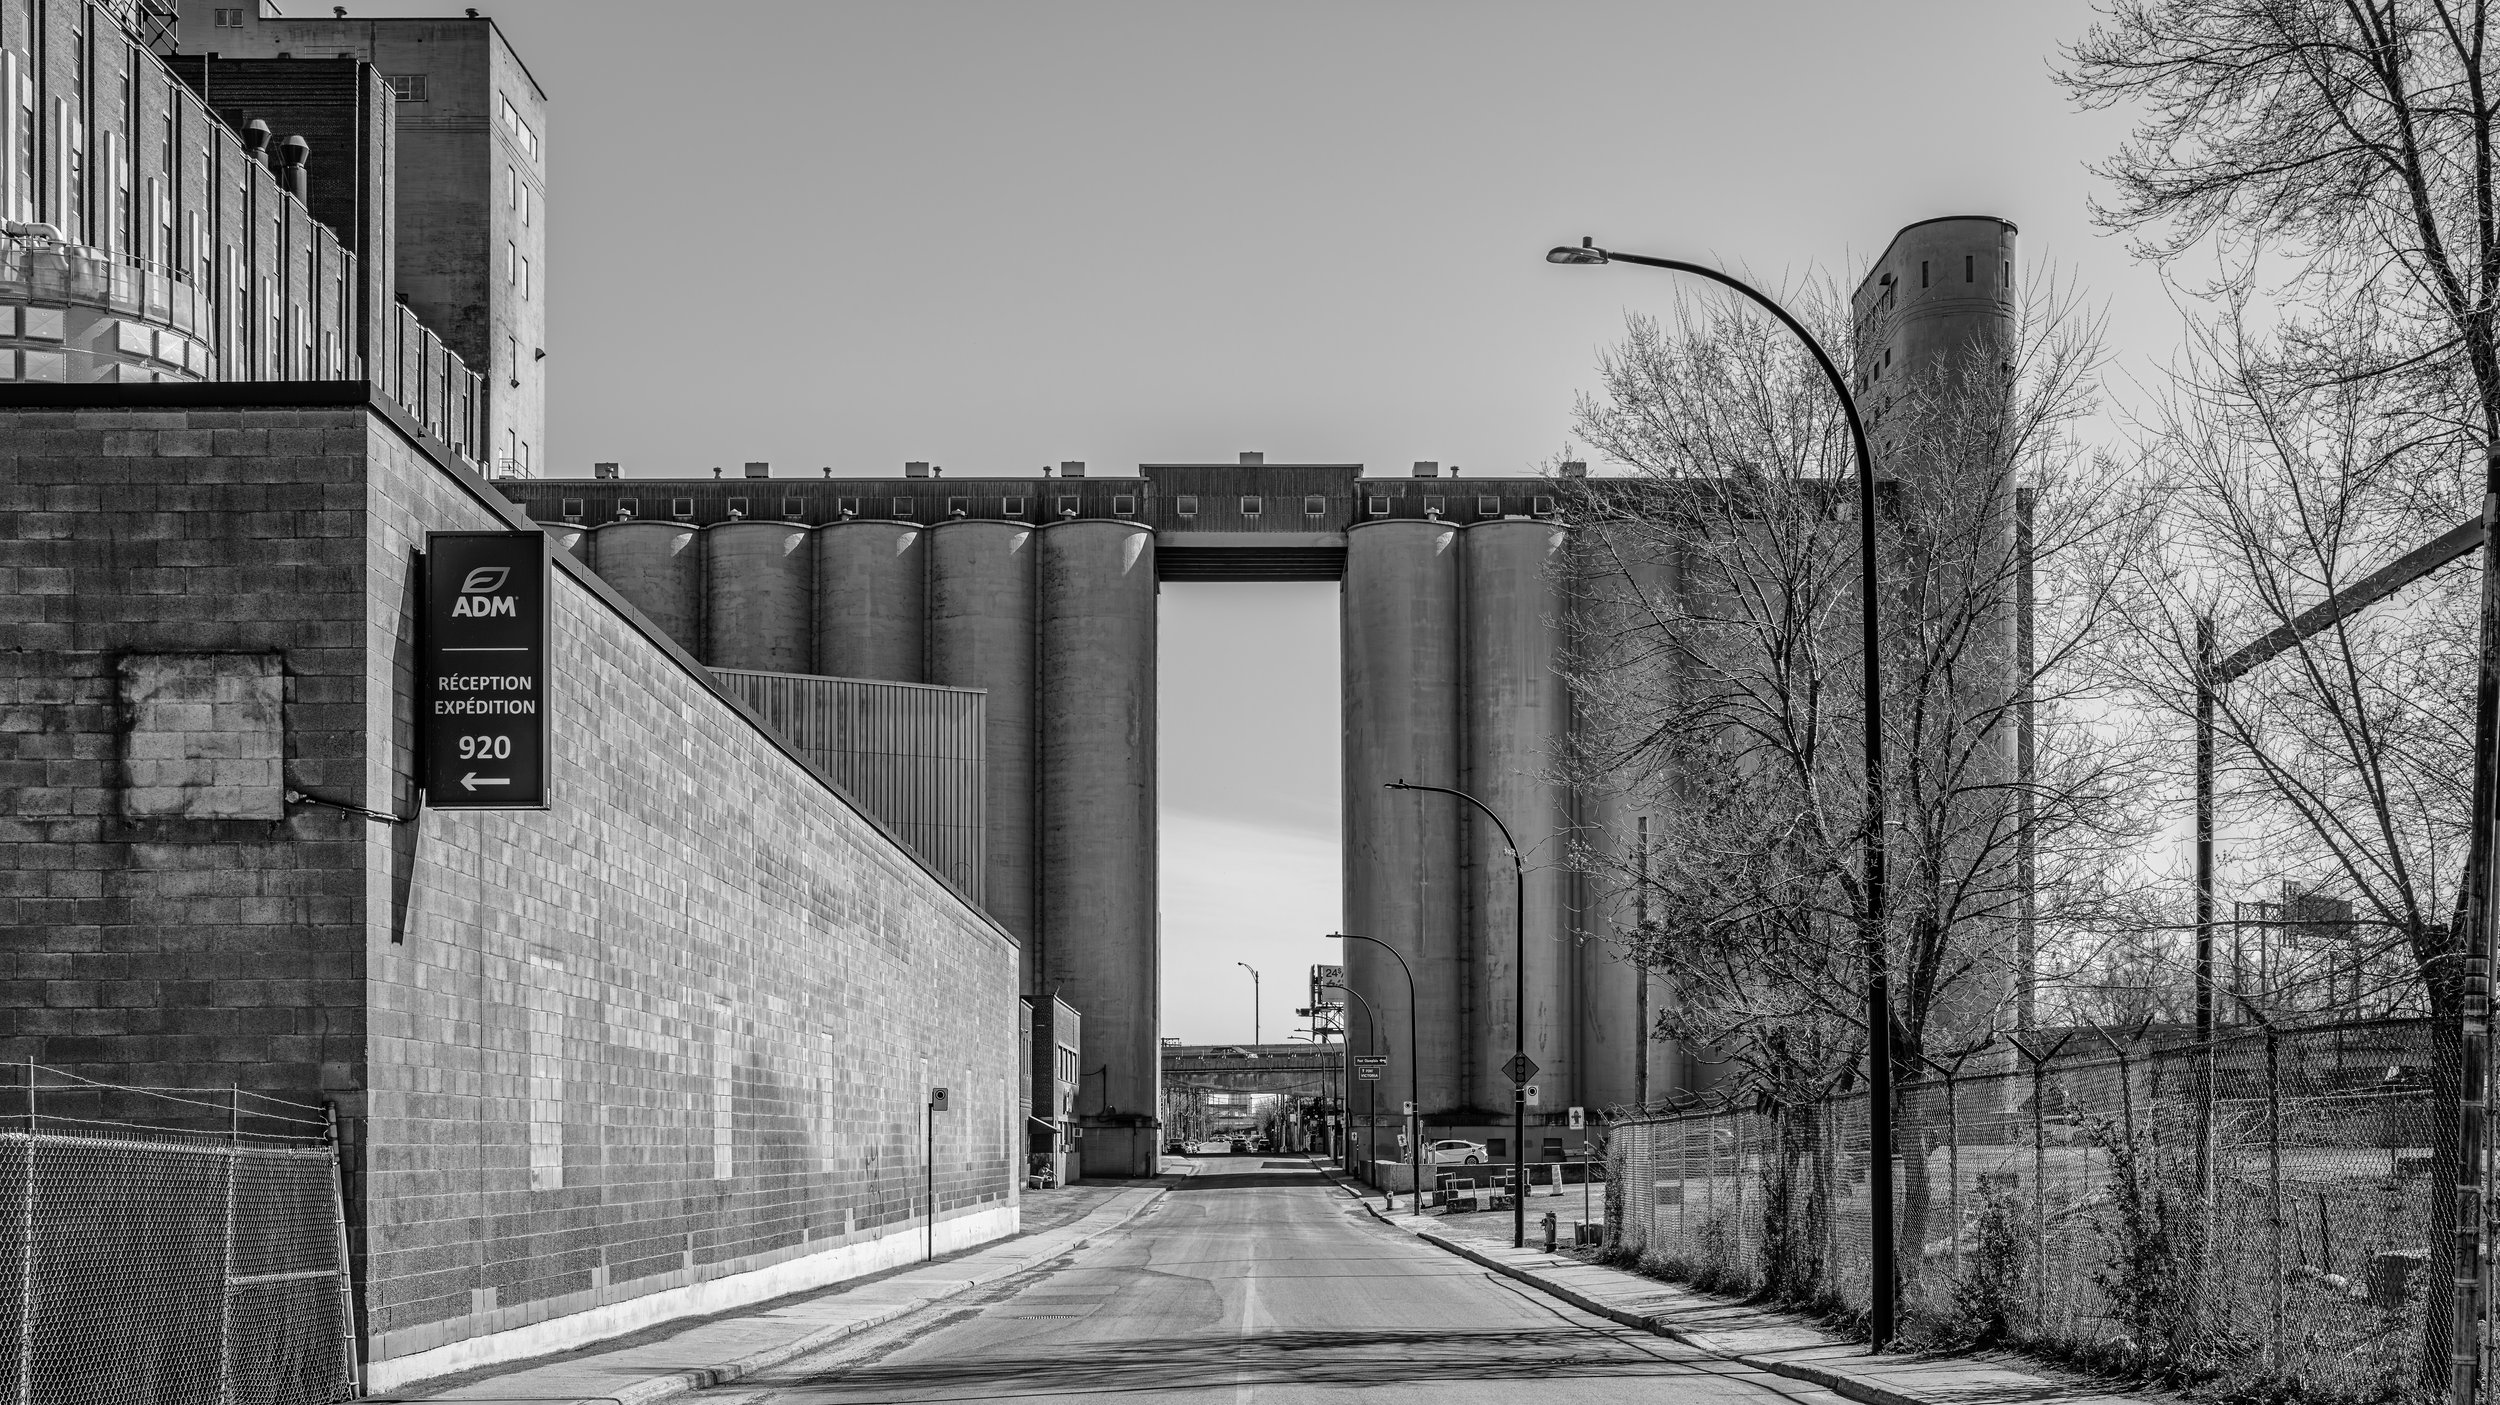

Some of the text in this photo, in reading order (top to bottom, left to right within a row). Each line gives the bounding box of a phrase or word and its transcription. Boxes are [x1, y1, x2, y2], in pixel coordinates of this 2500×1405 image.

[452, 596, 516, 617] ADM
[438, 673, 532, 691] RÉCEPTION
[434, 697, 536, 715] EXPÉDITION
[459, 735, 511, 760] 920
